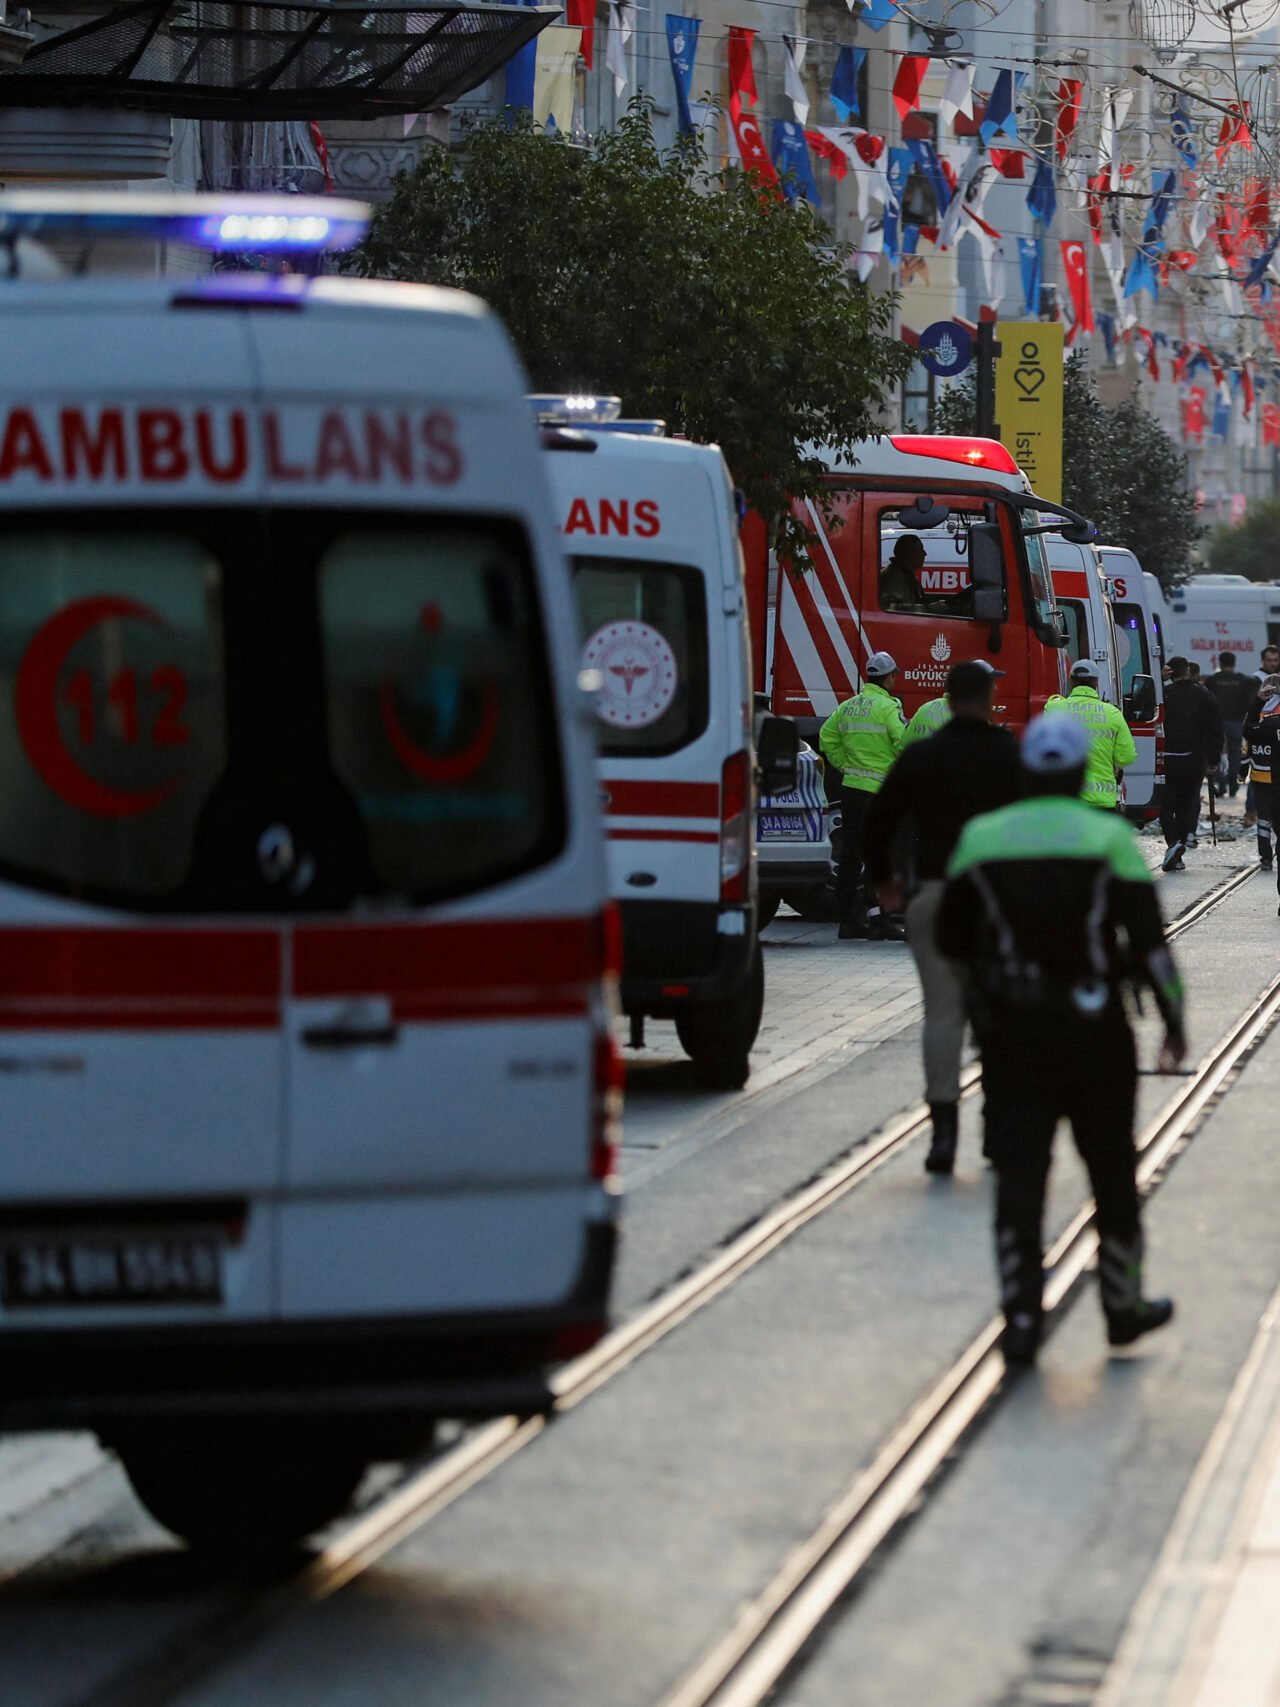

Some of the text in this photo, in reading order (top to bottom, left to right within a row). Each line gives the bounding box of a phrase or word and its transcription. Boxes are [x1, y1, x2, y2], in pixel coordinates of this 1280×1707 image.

[0, 406, 464, 487] AMBULANS
[561, 497, 661, 538] ANS
[921, 570, 972, 590] MBU
[63, 665, 191, 747] 112
